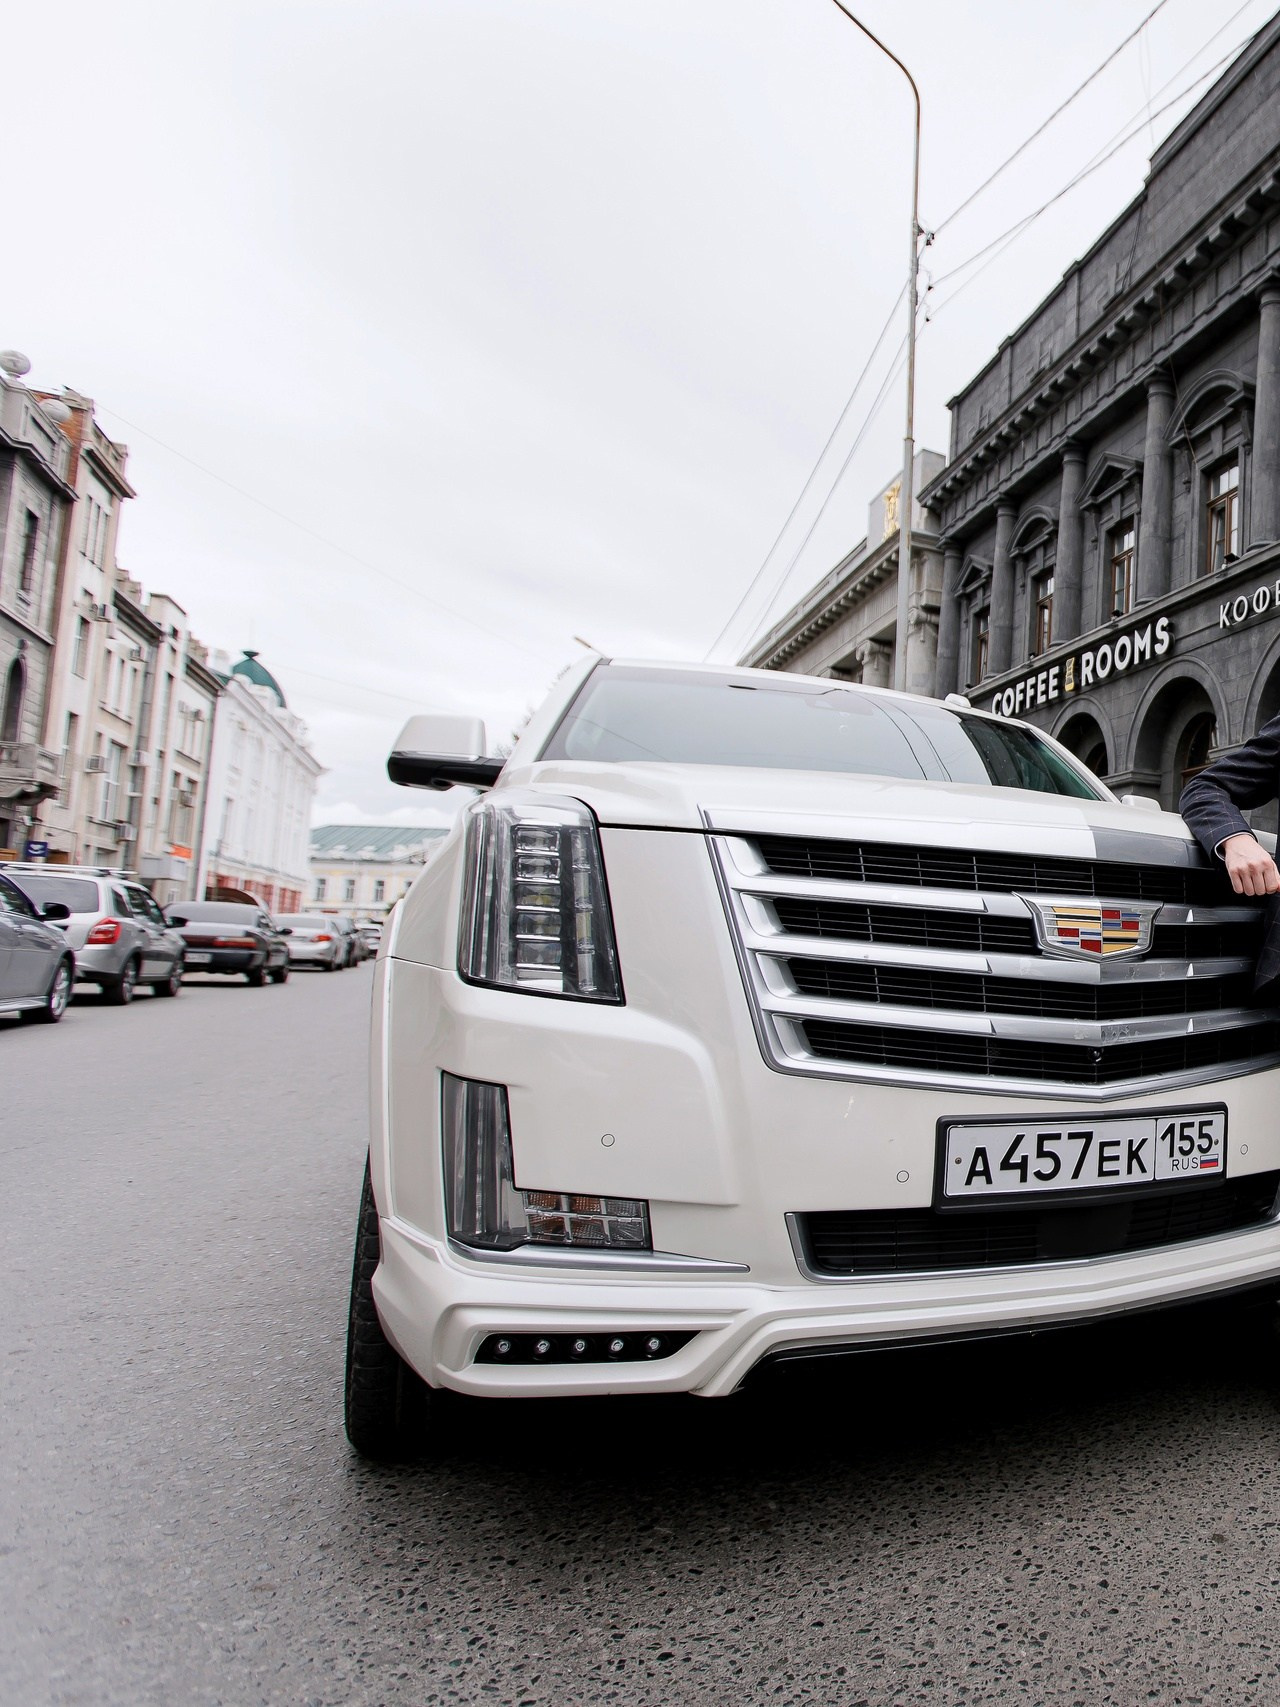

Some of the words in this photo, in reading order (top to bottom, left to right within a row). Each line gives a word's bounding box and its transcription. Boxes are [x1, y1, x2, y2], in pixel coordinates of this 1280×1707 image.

[992, 665, 1060, 717] COFFEE
[1081, 616, 1171, 687] ROOMS
[1159, 1119, 1214, 1158] 155
[1171, 1157, 1199, 1172] RUS
